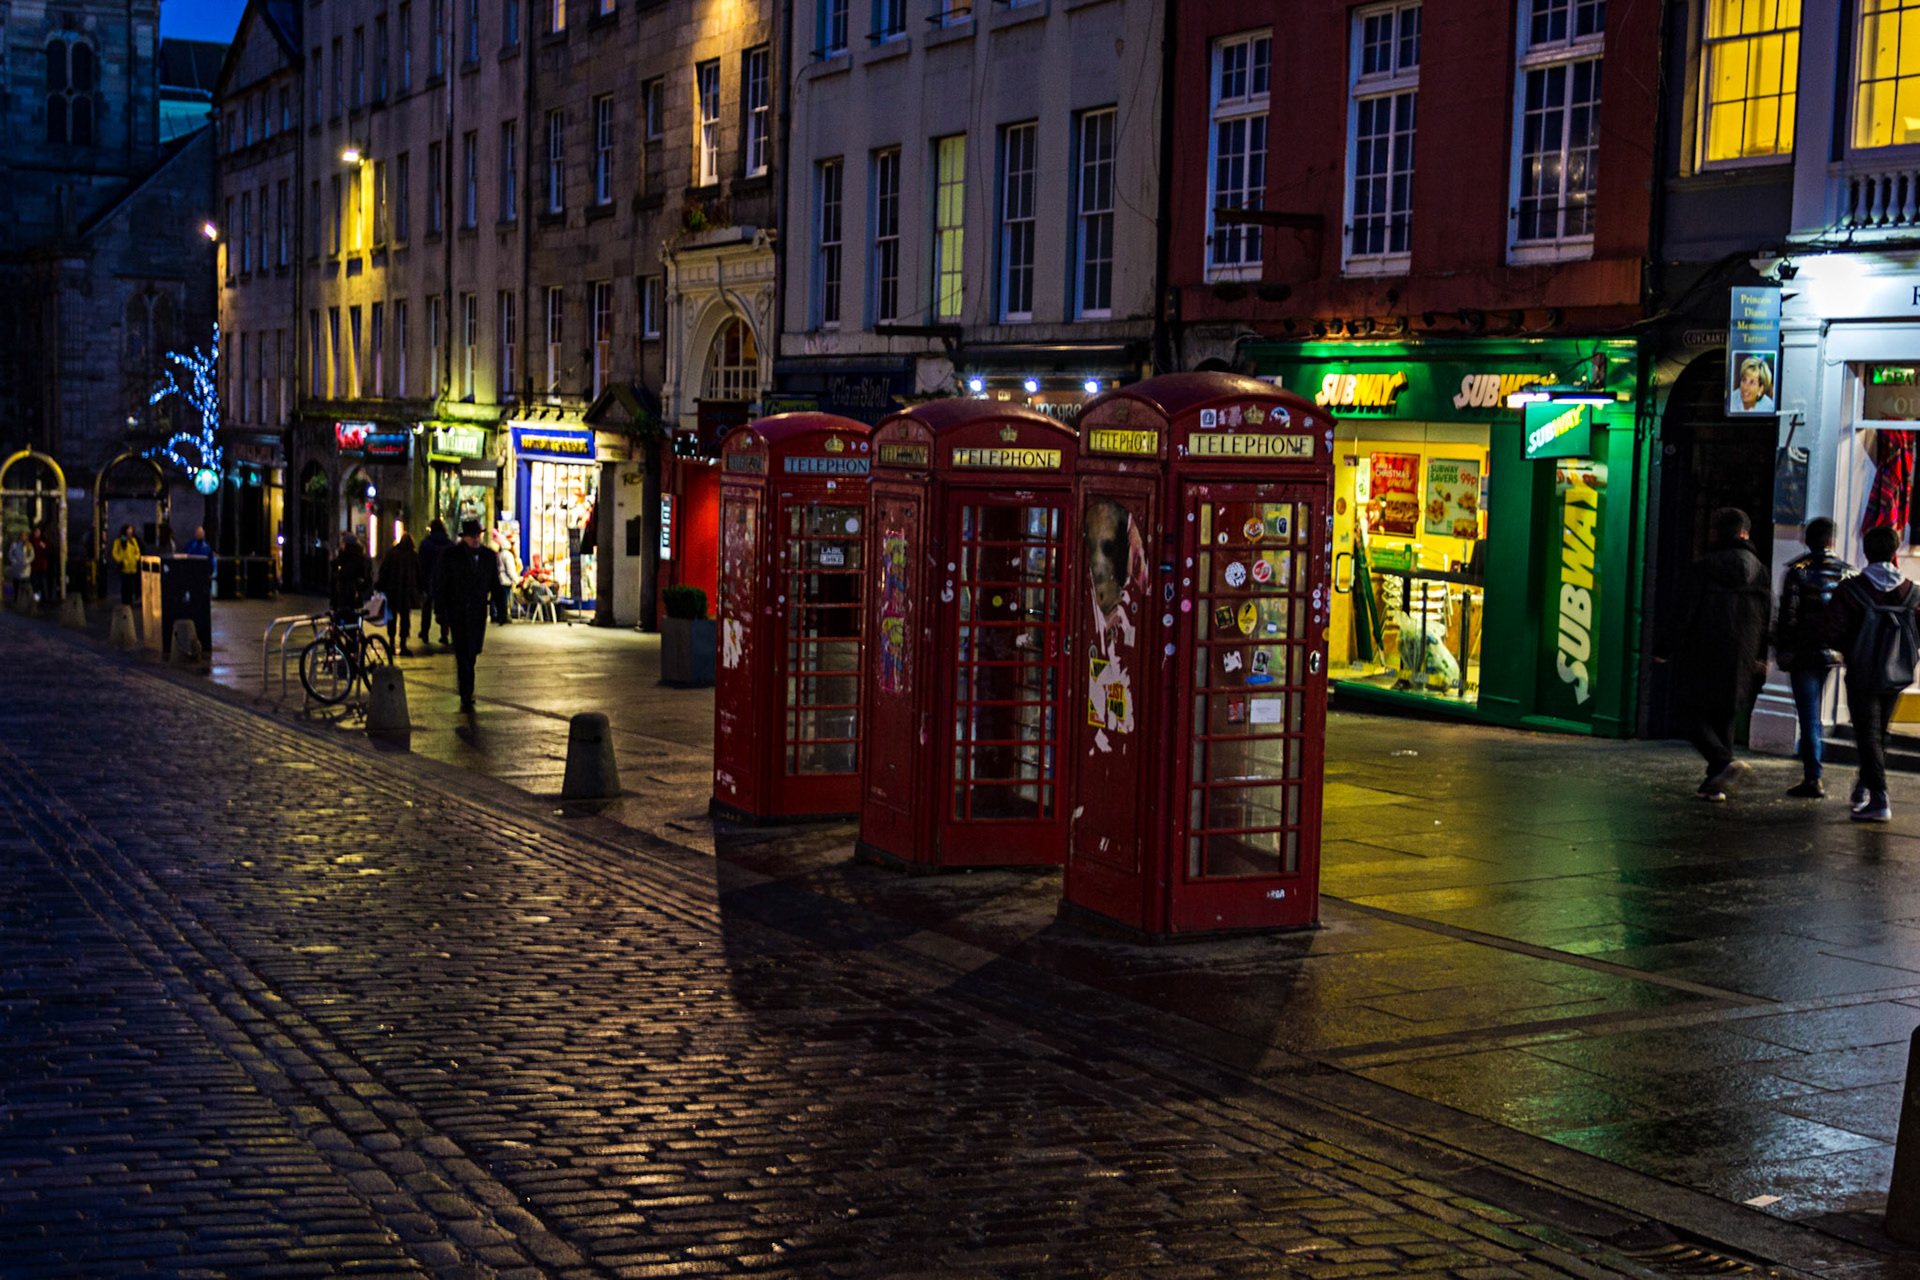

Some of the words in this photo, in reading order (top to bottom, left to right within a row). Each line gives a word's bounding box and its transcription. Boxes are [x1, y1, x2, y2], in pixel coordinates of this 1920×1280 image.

[1740, 293, 1771, 304] Princess
[1744, 306, 1767, 317] Diana
[1737, 320, 1774, 330] Memorial
[1741, 333, 1767, 344] Tartan
[1315, 371, 1407, 407] SUBWAY
[1527, 403, 1586, 454] SUBWAY
[1193, 434, 1310, 456] TELEPHONE
[958, 449, 1056, 468] TELEPHONE
[788, 458, 868, 473] TELEPHON
[1430, 464, 1459, 473] SUBWAY
[1375, 469, 1410, 479] CHRISTMAS
[1430, 473, 1459, 484] SAVERS
[1460, 473, 1477, 488] 99p
[1556, 459, 1598, 705] SUBWAY
